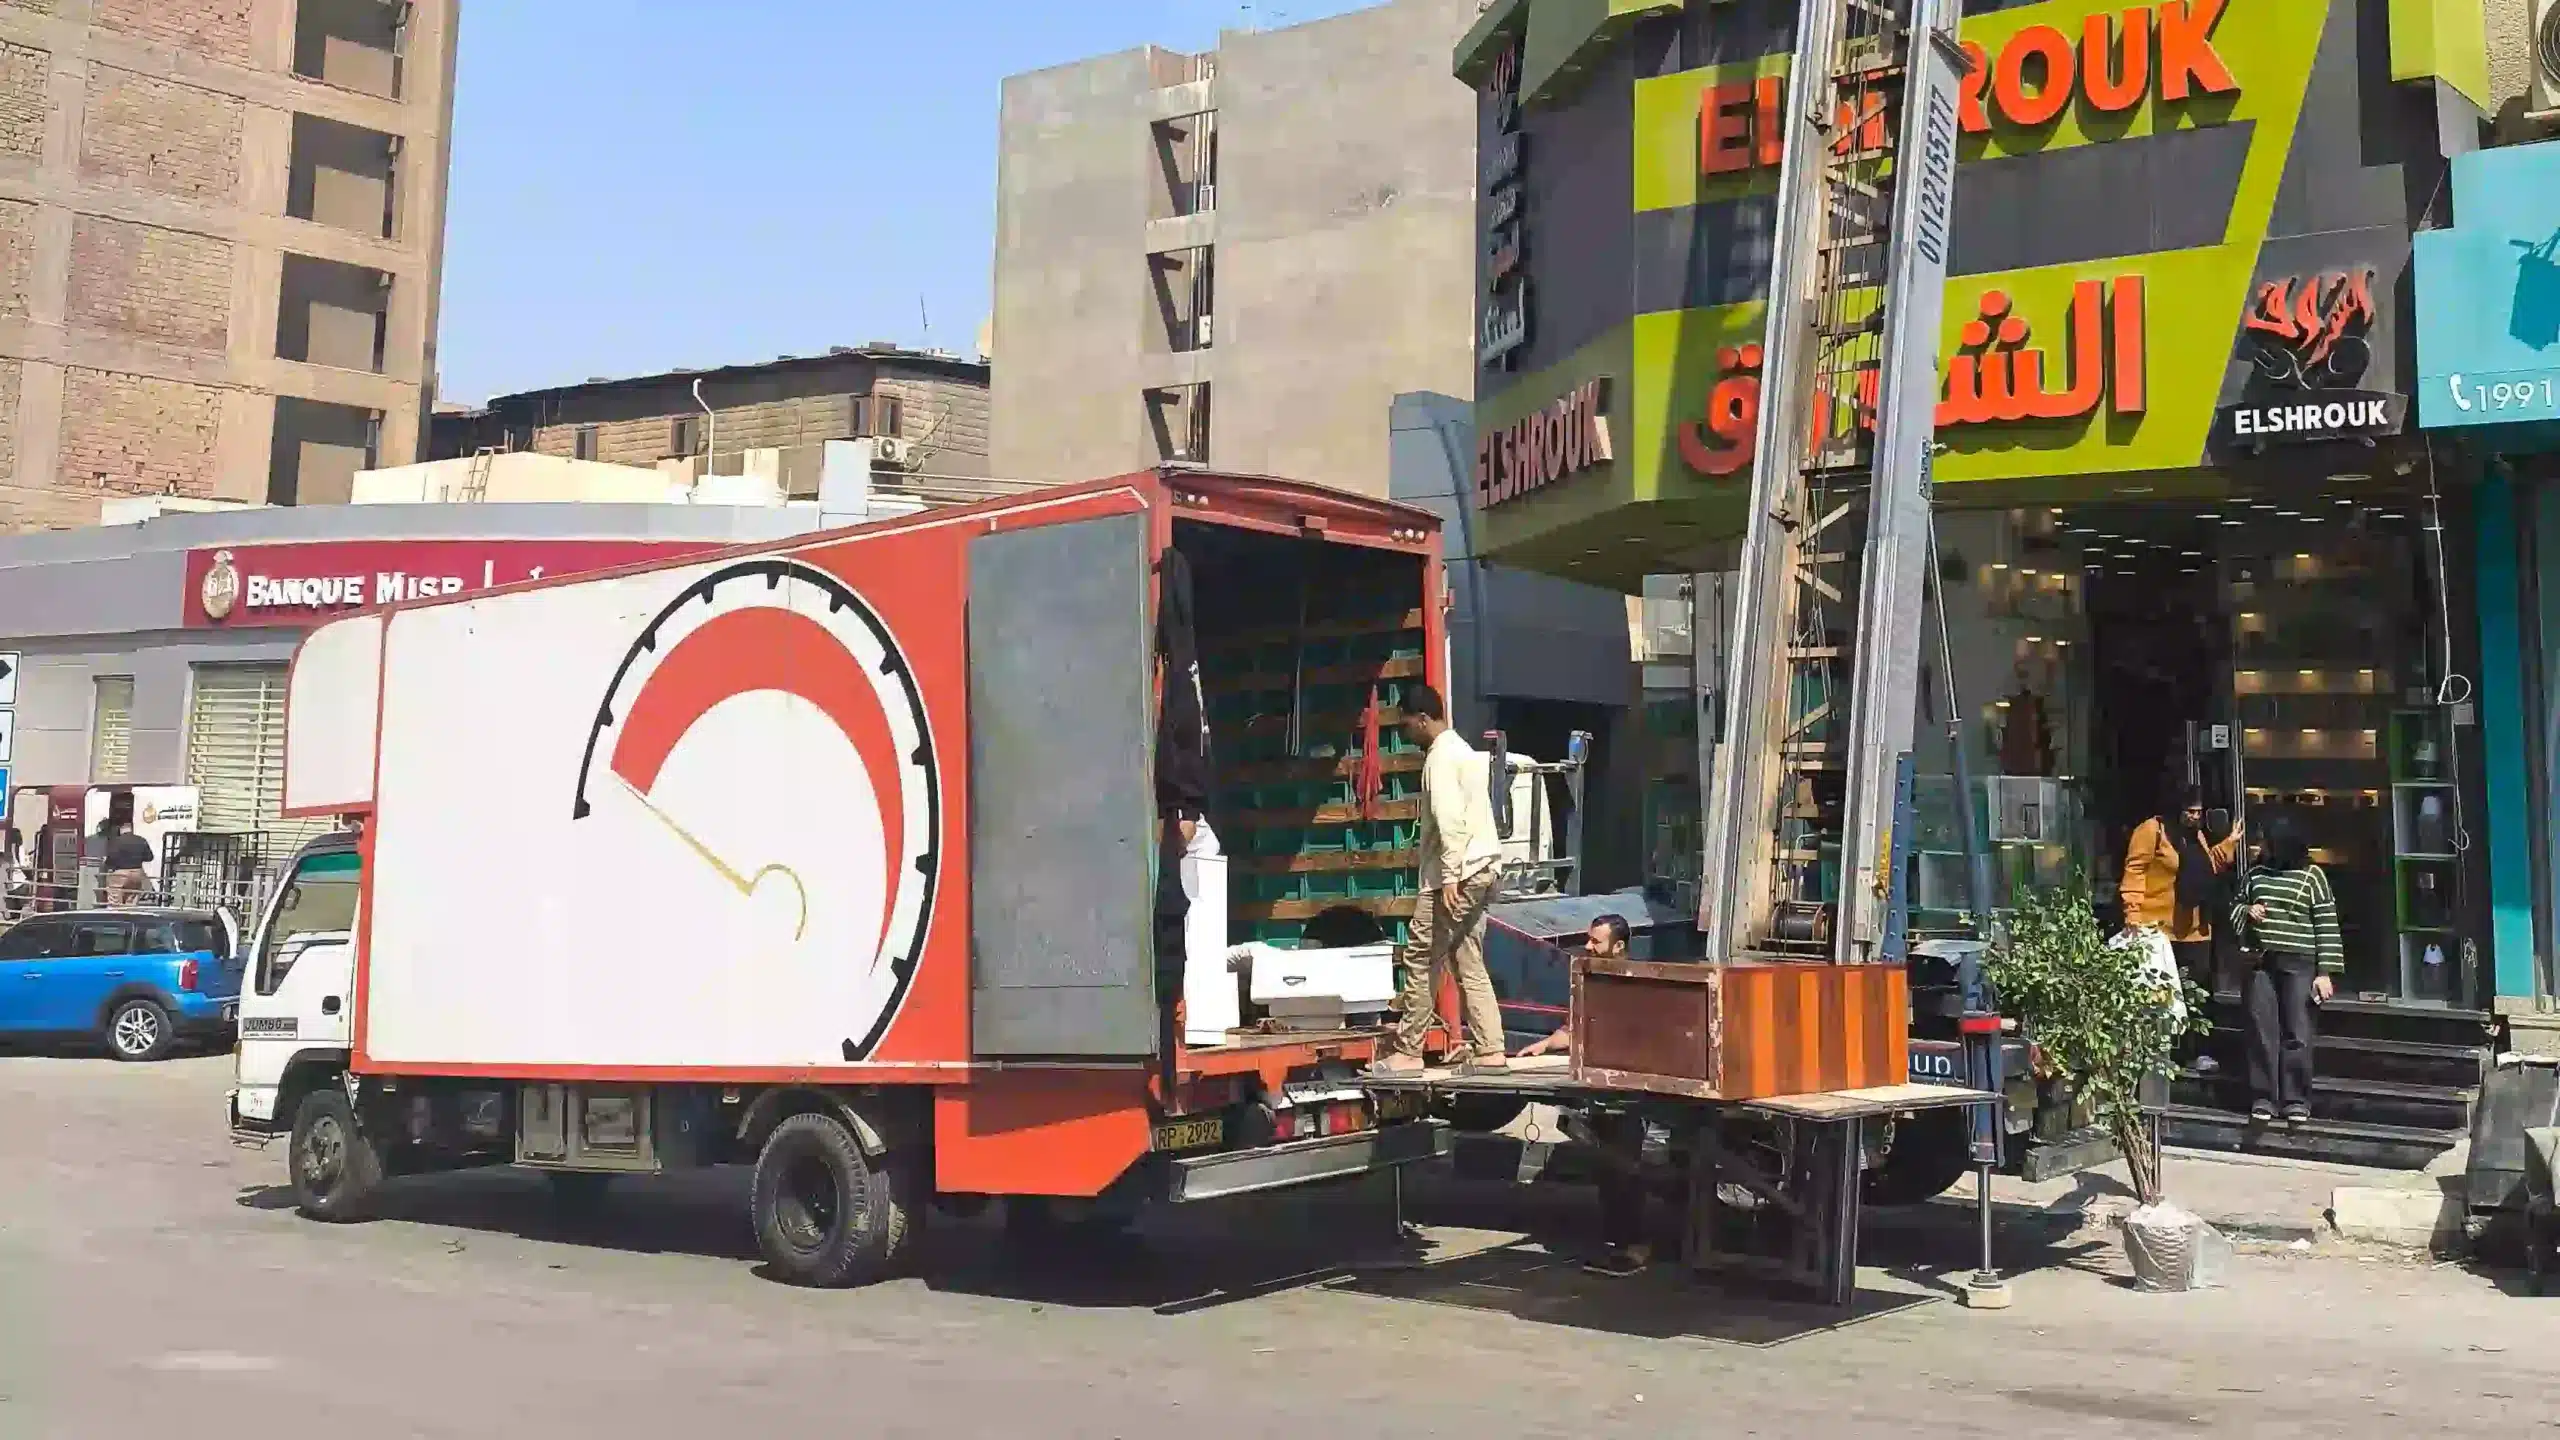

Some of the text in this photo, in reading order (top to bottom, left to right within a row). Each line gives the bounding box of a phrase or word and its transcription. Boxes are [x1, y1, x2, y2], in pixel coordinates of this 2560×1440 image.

[1702, 0, 2241, 174] ELROUK
[1917, 84, 1954, 265] 01122155777
[2234, 400, 2389, 434] ELSHROUK
[2475, 379, 2553, 412] 1991
[1475, 376, 1613, 510] ELSHROUK
[246, 575, 365, 609] BANQUE
